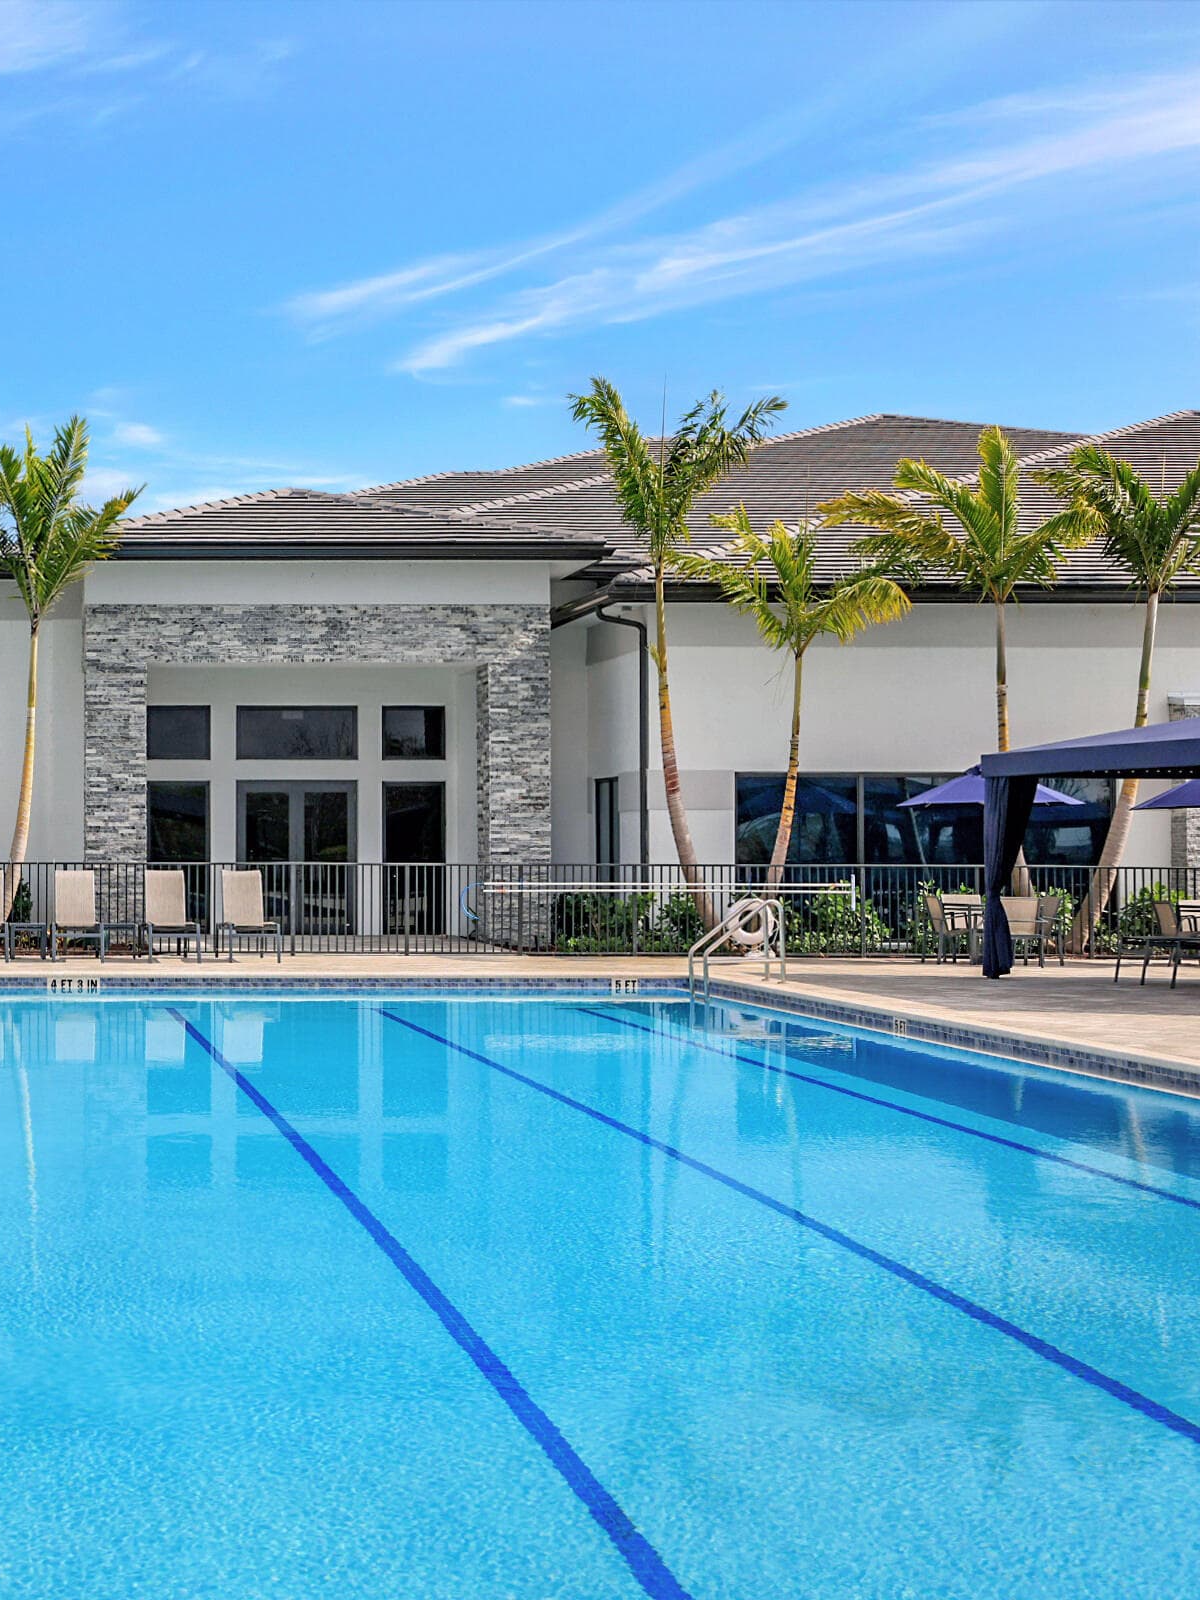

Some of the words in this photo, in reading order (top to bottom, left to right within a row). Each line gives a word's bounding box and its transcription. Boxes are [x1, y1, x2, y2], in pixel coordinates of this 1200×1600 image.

[51, 979, 57, 988] 4
[61, 979, 72, 988] FT
[77, 979, 83, 988] 3
[87, 979, 97, 988] IN
[615, 980, 621, 988] 5
[625, 980, 636, 988] FT
